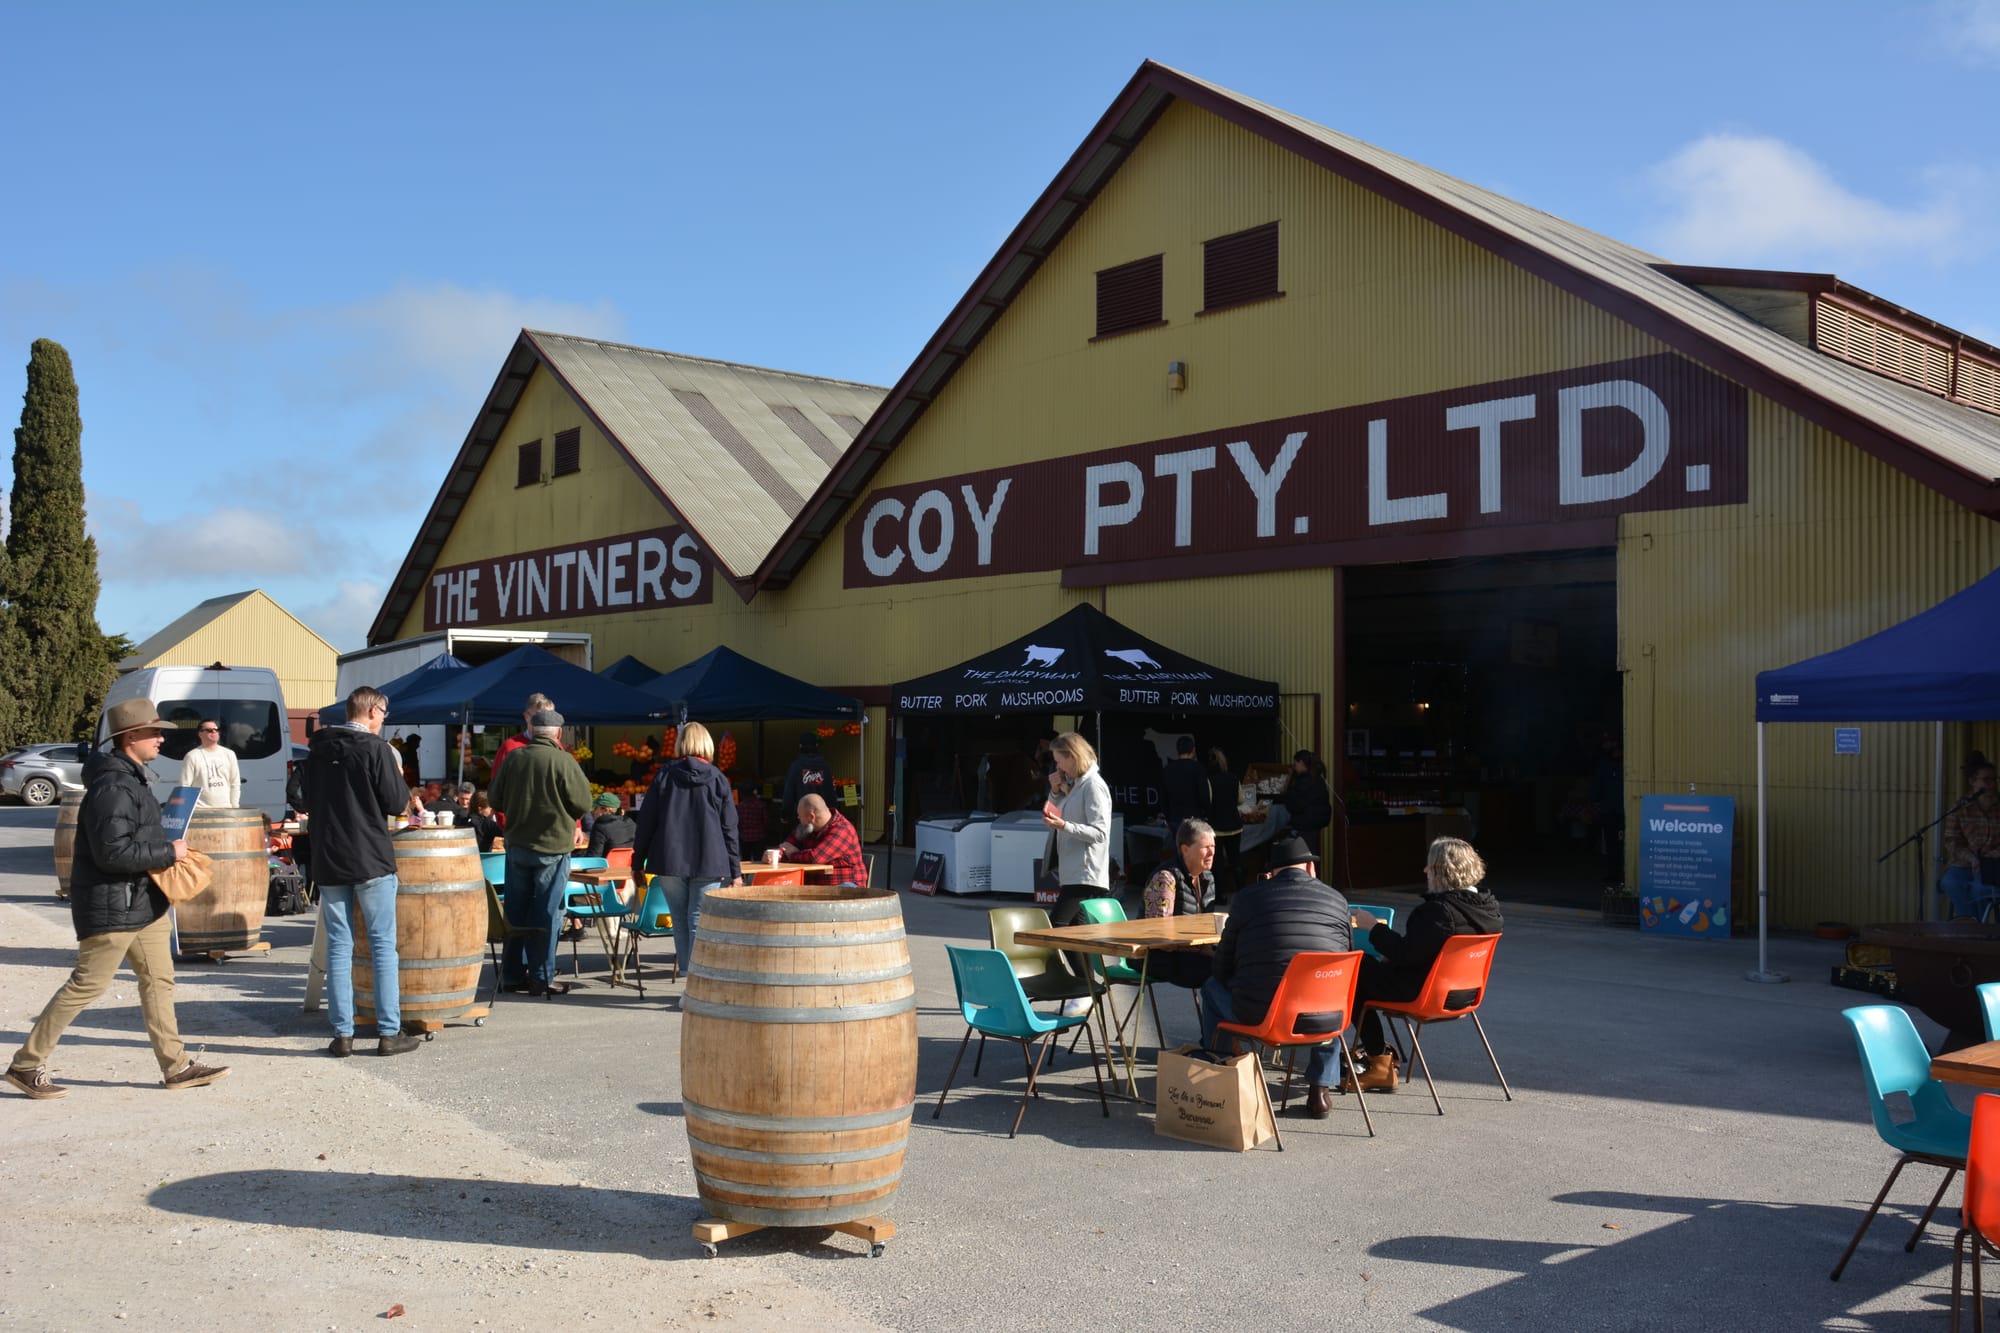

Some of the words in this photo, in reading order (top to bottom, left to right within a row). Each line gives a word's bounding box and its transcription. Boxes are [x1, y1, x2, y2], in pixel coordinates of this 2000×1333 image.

[862, 479, 1012, 577] COY
[1084, 432, 1308, 555] PTY.
[1368, 380, 1710, 526] LTD.
[433, 568, 480, 624] THE
[494, 533, 702, 617] VINTNERS
[963, 669, 995, 678] THE
[998, 670, 1081, 680] DAIRYMAN
[1136, 672, 1213, 680] DAIRYMAN
[900, 696, 942, 709] BUTTER
[955, 694, 988, 708] PORK
[1001, 688, 1084, 706] MUSHROOMS
[1120, 689, 1160, 704] BUTTER
[1171, 692, 1199, 705] PORK
[1209, 694, 1274, 708] MUSHROOMS
[1650, 819, 1724, 834] Welcome
